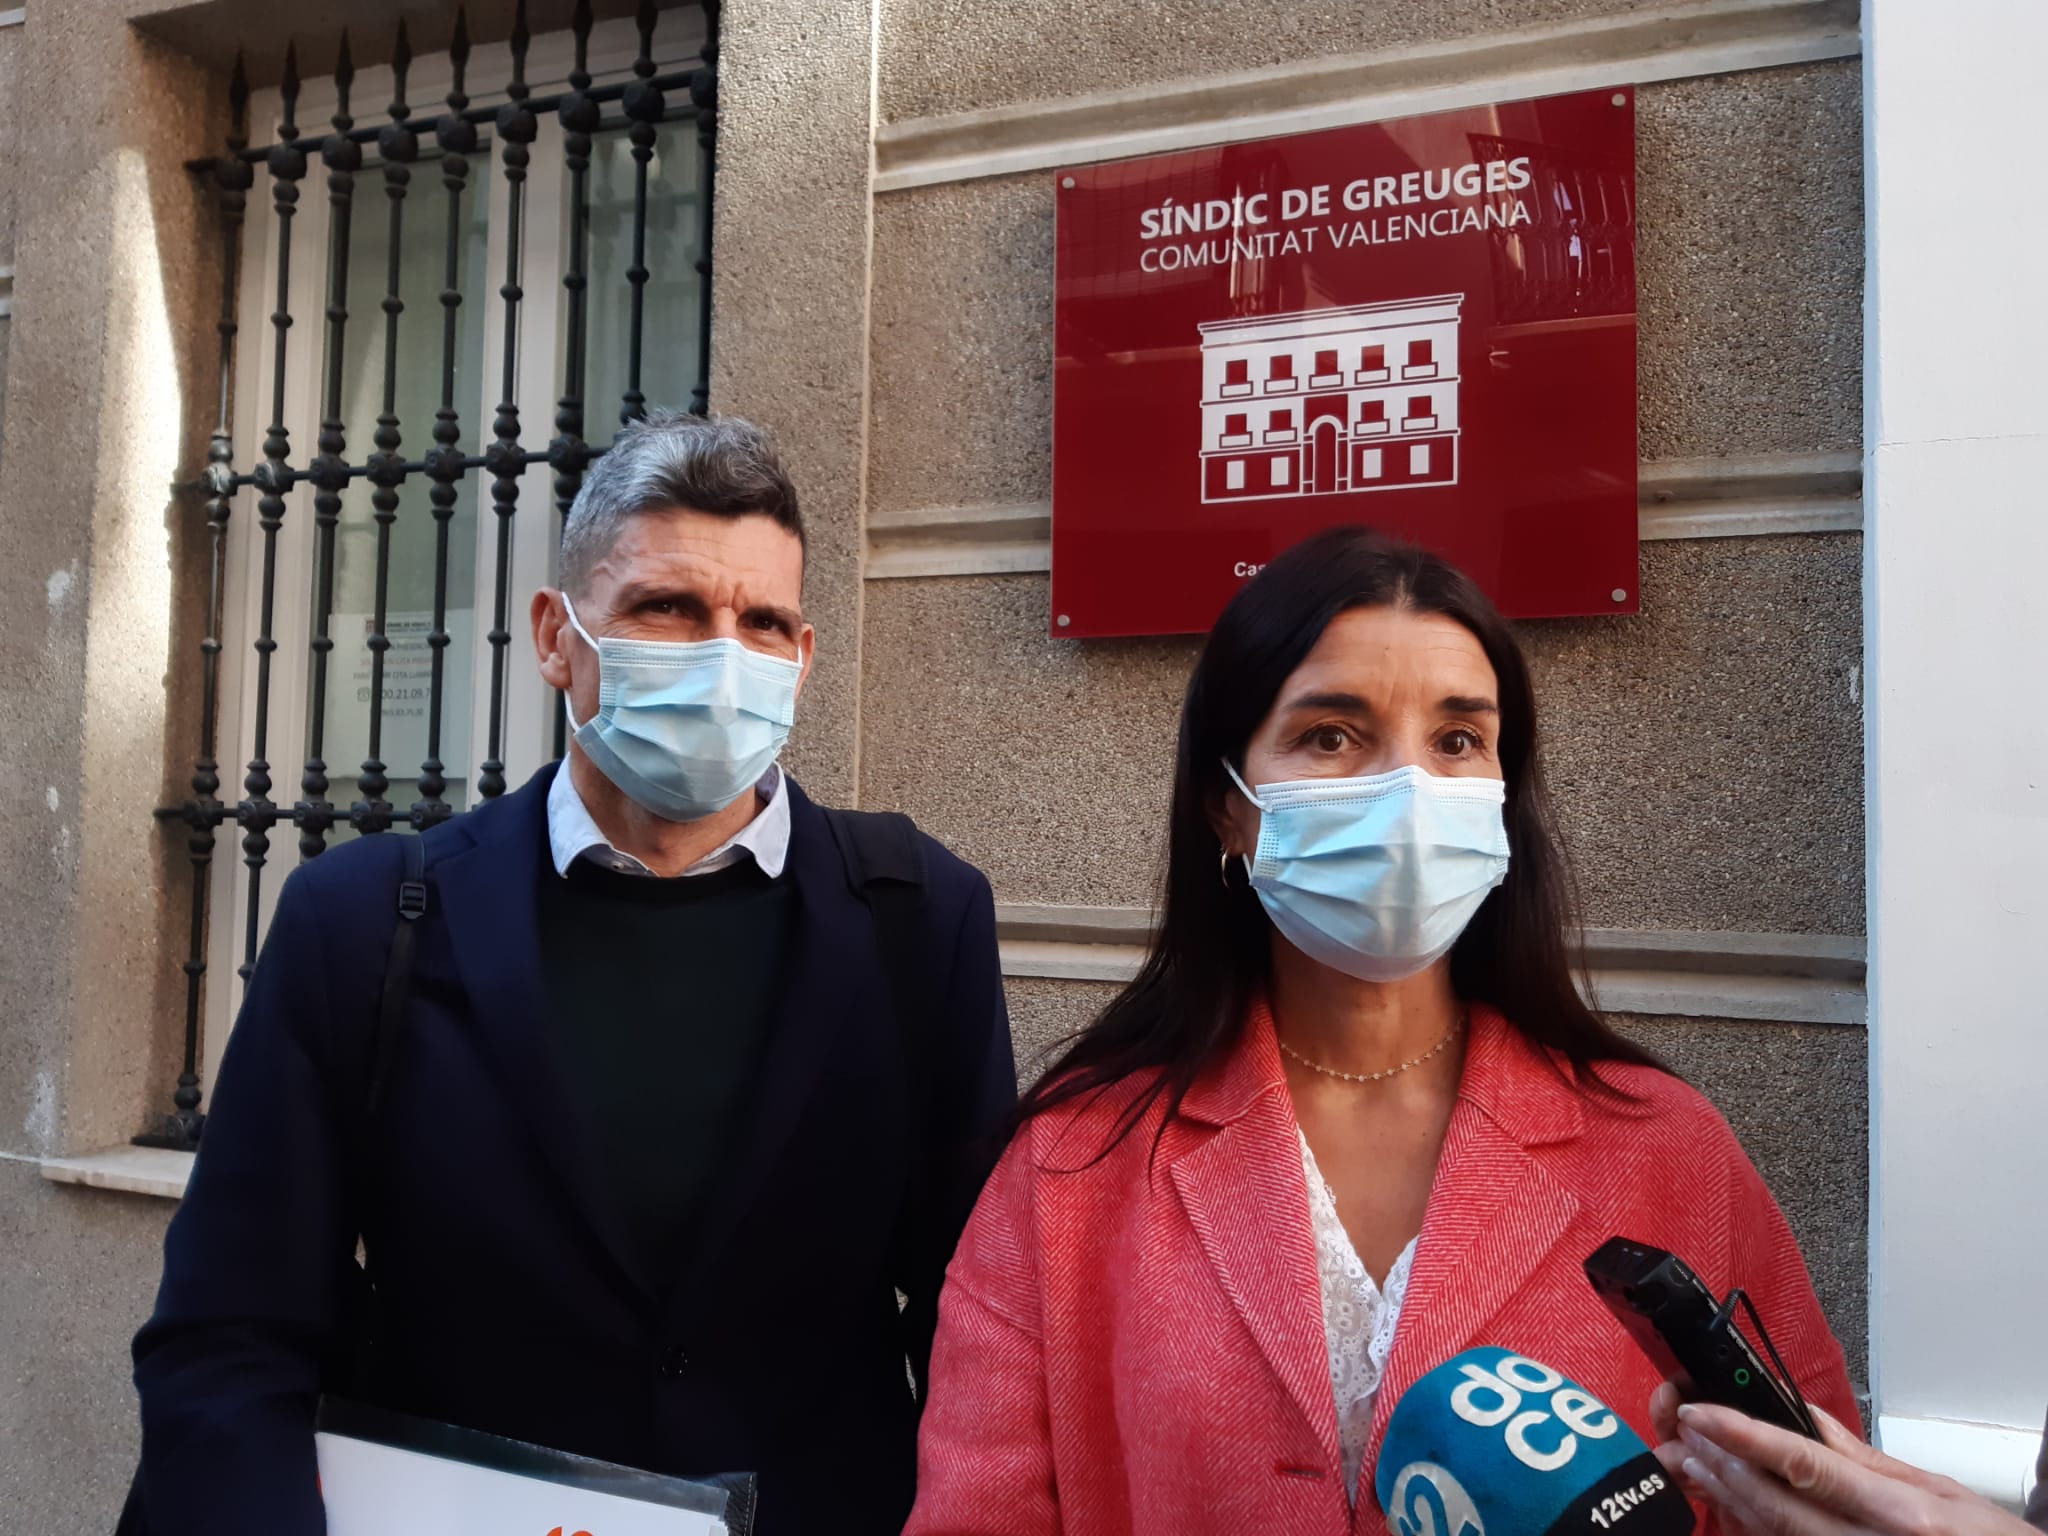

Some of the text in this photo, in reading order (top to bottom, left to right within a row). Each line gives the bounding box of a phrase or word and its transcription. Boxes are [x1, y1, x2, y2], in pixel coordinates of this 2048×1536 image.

[1140, 157, 1531, 239] SÍNDIC DE GREUGES
[1140, 200, 1532, 272] COMUNITAT VALENCIANA
[1591, 1473, 1665, 1529] 12tv.es
